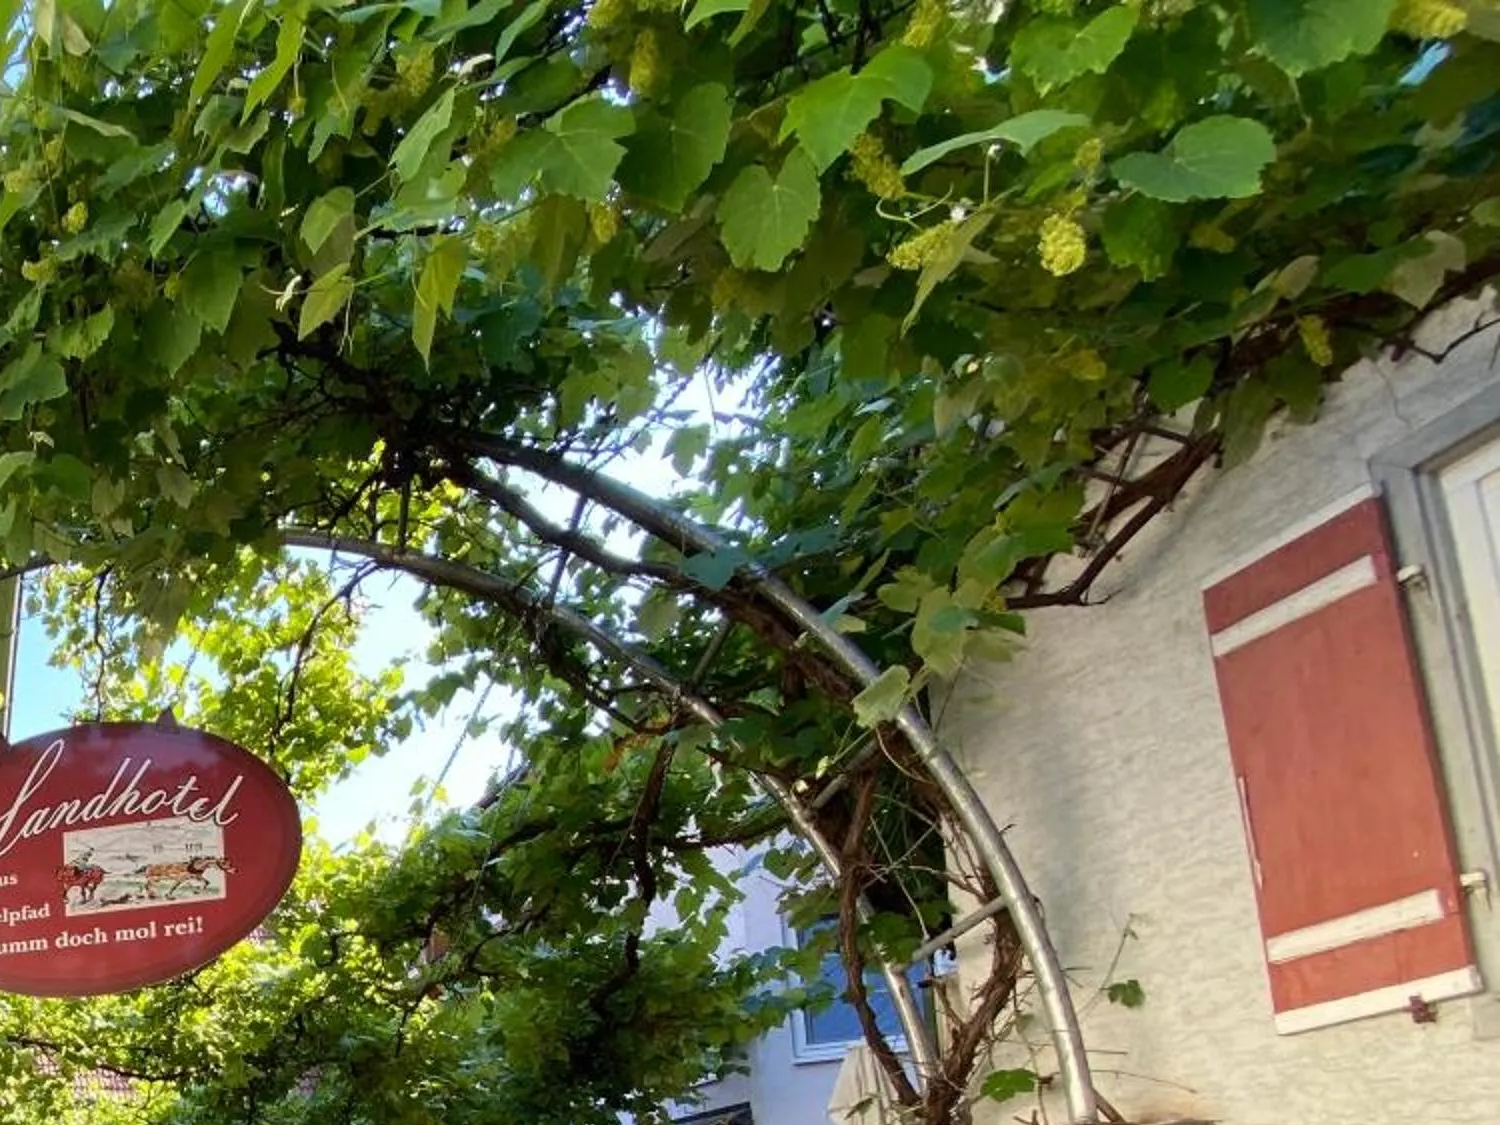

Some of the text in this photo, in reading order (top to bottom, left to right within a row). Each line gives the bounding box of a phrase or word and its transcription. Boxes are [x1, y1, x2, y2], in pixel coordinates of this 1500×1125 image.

[55, 929, 108, 950] doch
[116, 920, 157, 942] mol
[163, 916, 204, 939] rei!
